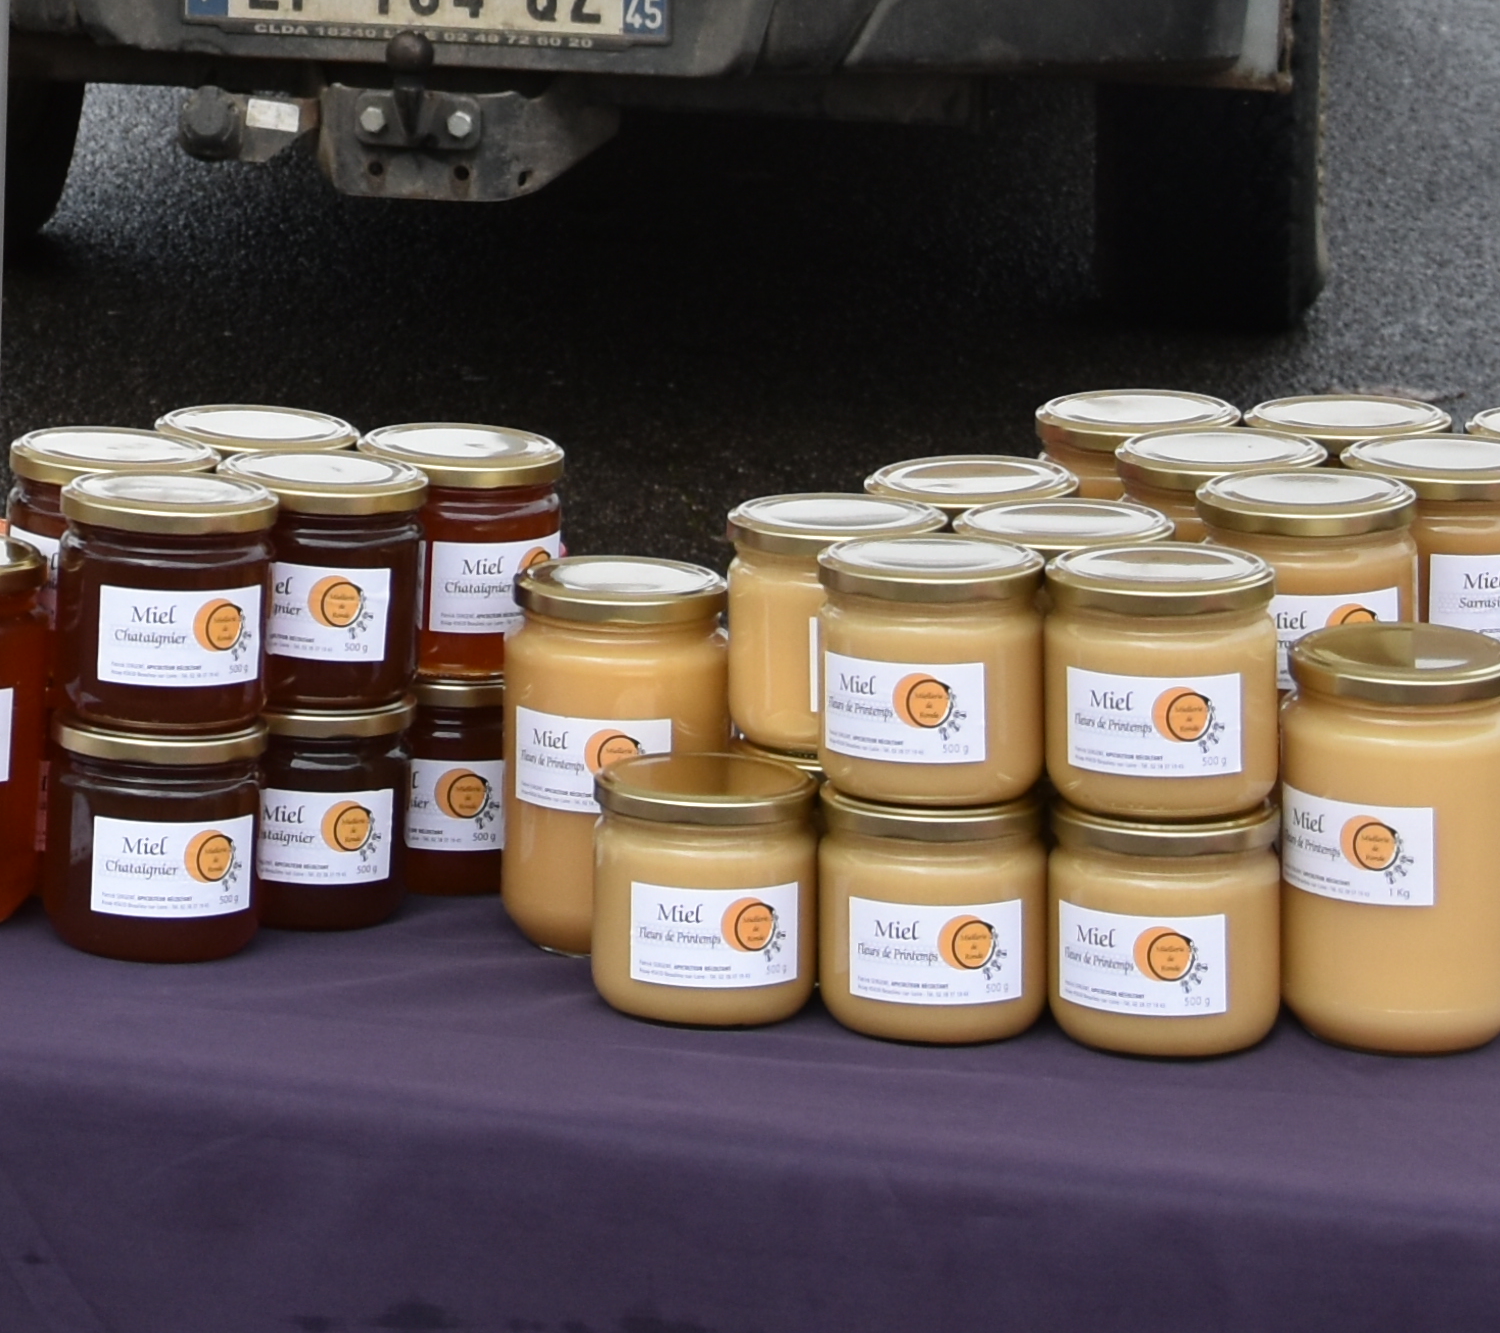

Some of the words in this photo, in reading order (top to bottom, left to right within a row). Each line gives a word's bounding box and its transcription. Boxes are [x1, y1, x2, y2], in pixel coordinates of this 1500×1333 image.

[254, 23, 308, 36] CLDA
[462, 557, 504, 575] Miel
[131, 605, 176, 624] Miel
[840, 673, 876, 695] Miel
[855, 701, 893, 719] Printemps
[1090, 690, 1134, 711] Miel
[1098, 716, 1106, 729] de
[1108, 719, 1152, 737] Printemps
[533, 729, 569, 749] Miel
[547, 756, 585, 775] Printemps
[263, 805, 305, 824] Miel
[1293, 808, 1324, 833] Miel
[122, 836, 169, 855] Miel
[657, 903, 704, 924] Miel
[639, 926, 662, 941] Fleurs
[665, 931, 674, 942] de
[677, 931, 721, 949] Printemps
[874, 920, 921, 940] Miel
[1077, 925, 1115, 948] Miel
[858, 943, 881, 957] Fleurs
[883, 946, 892, 957] de
[894, 947, 938, 965] Printemps
[1093, 954, 1134, 975] Printemps
